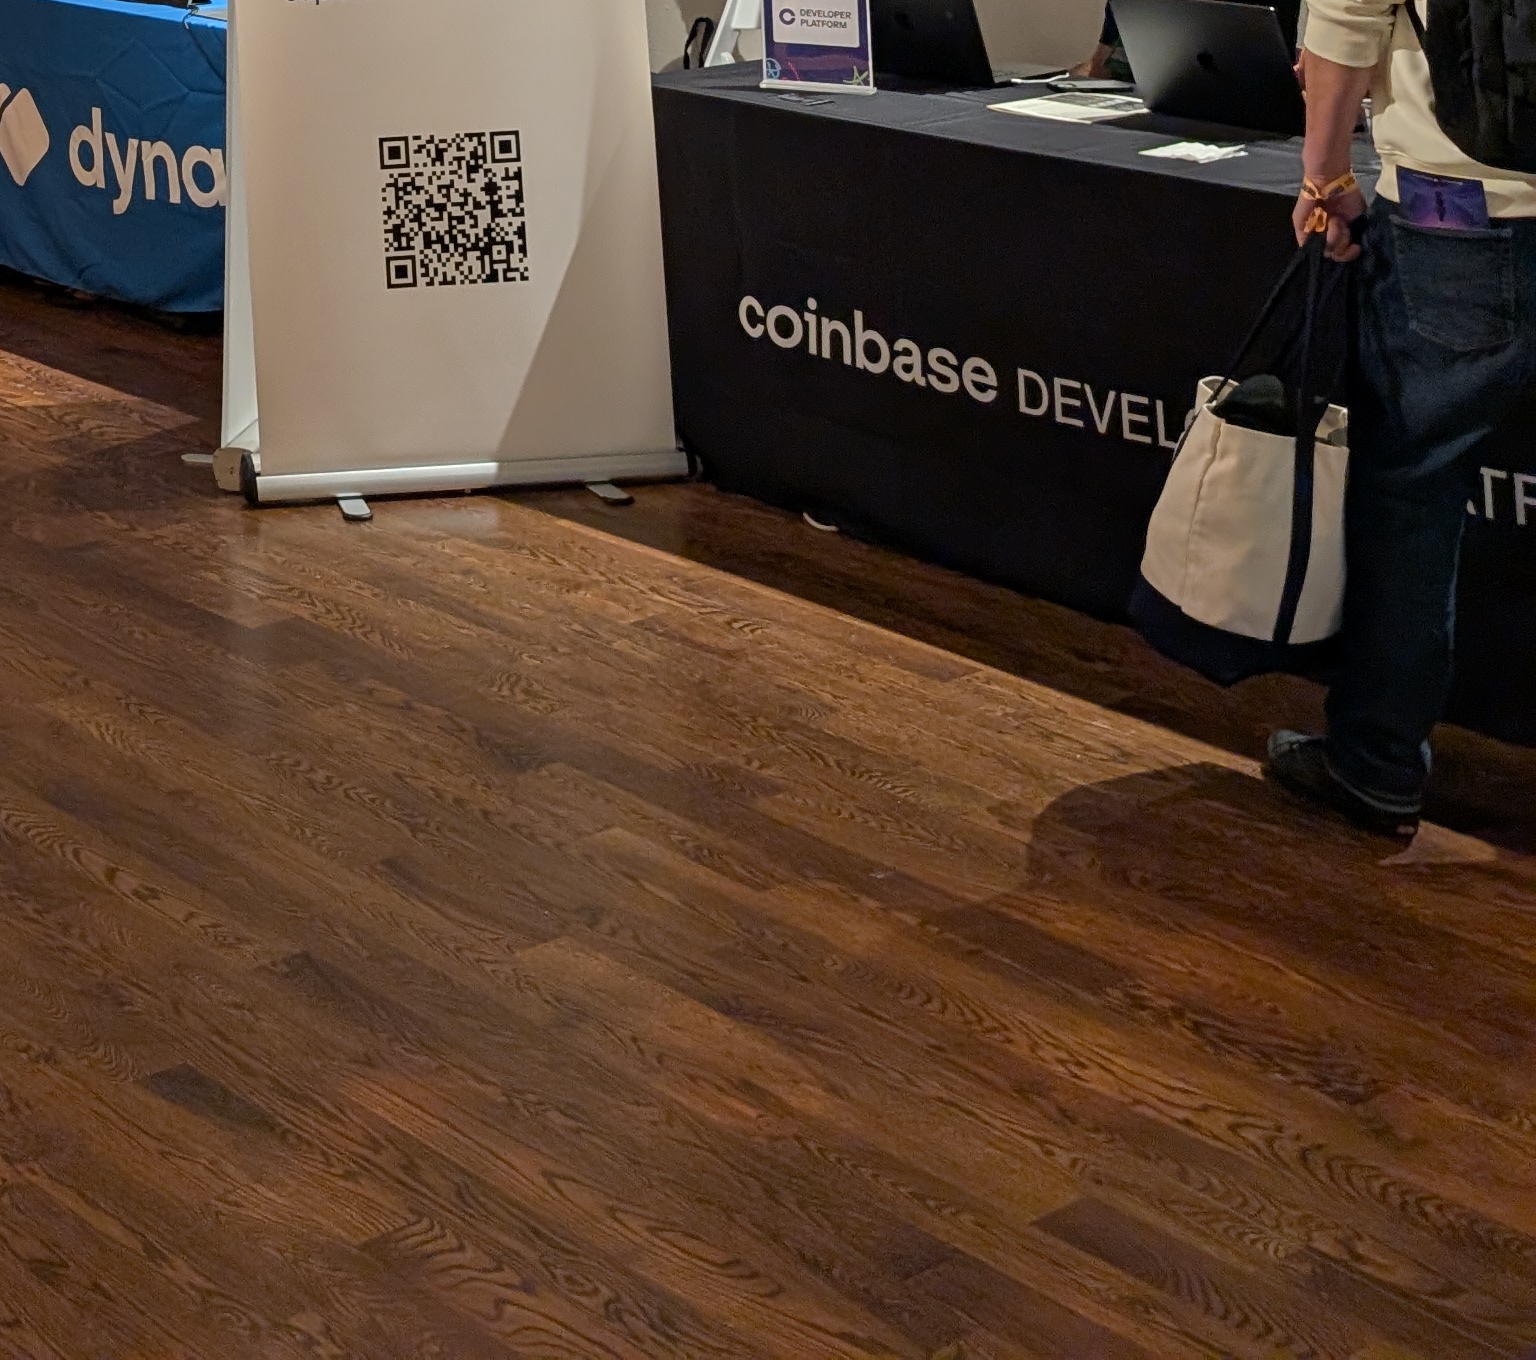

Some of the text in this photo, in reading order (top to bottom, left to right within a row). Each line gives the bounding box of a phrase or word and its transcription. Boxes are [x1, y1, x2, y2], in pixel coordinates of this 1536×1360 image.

[800, 8, 852, 19] DEVELOPER
[800, 18, 848, 29] PLATFORM
[69, 106, 227, 215] dyna
[738, 295, 1194, 449] coinbase DEVEL
